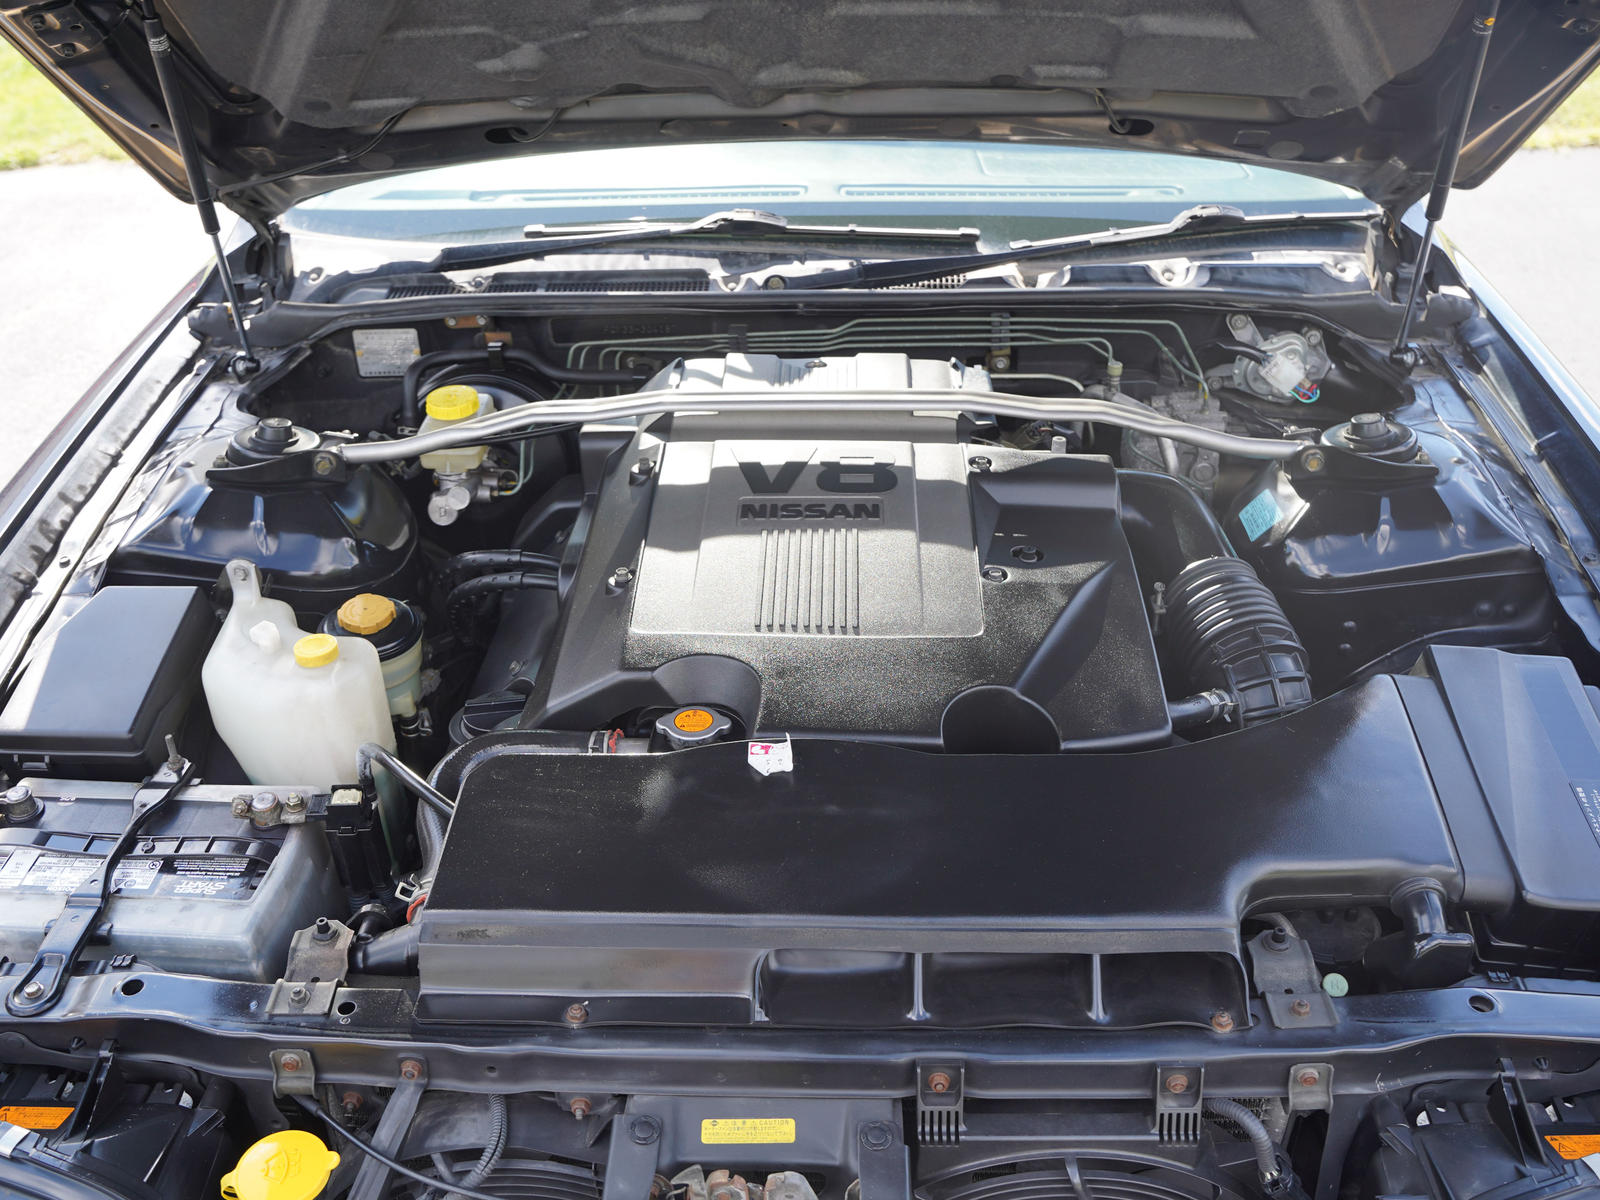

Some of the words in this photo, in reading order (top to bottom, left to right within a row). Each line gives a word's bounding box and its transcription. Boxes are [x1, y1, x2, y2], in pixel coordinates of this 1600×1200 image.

[730, 447, 898, 494] V8
[739, 503, 881, 520] NISSAN
[173, 887, 217, 895] SUPER
[177, 880, 228, 890] START
